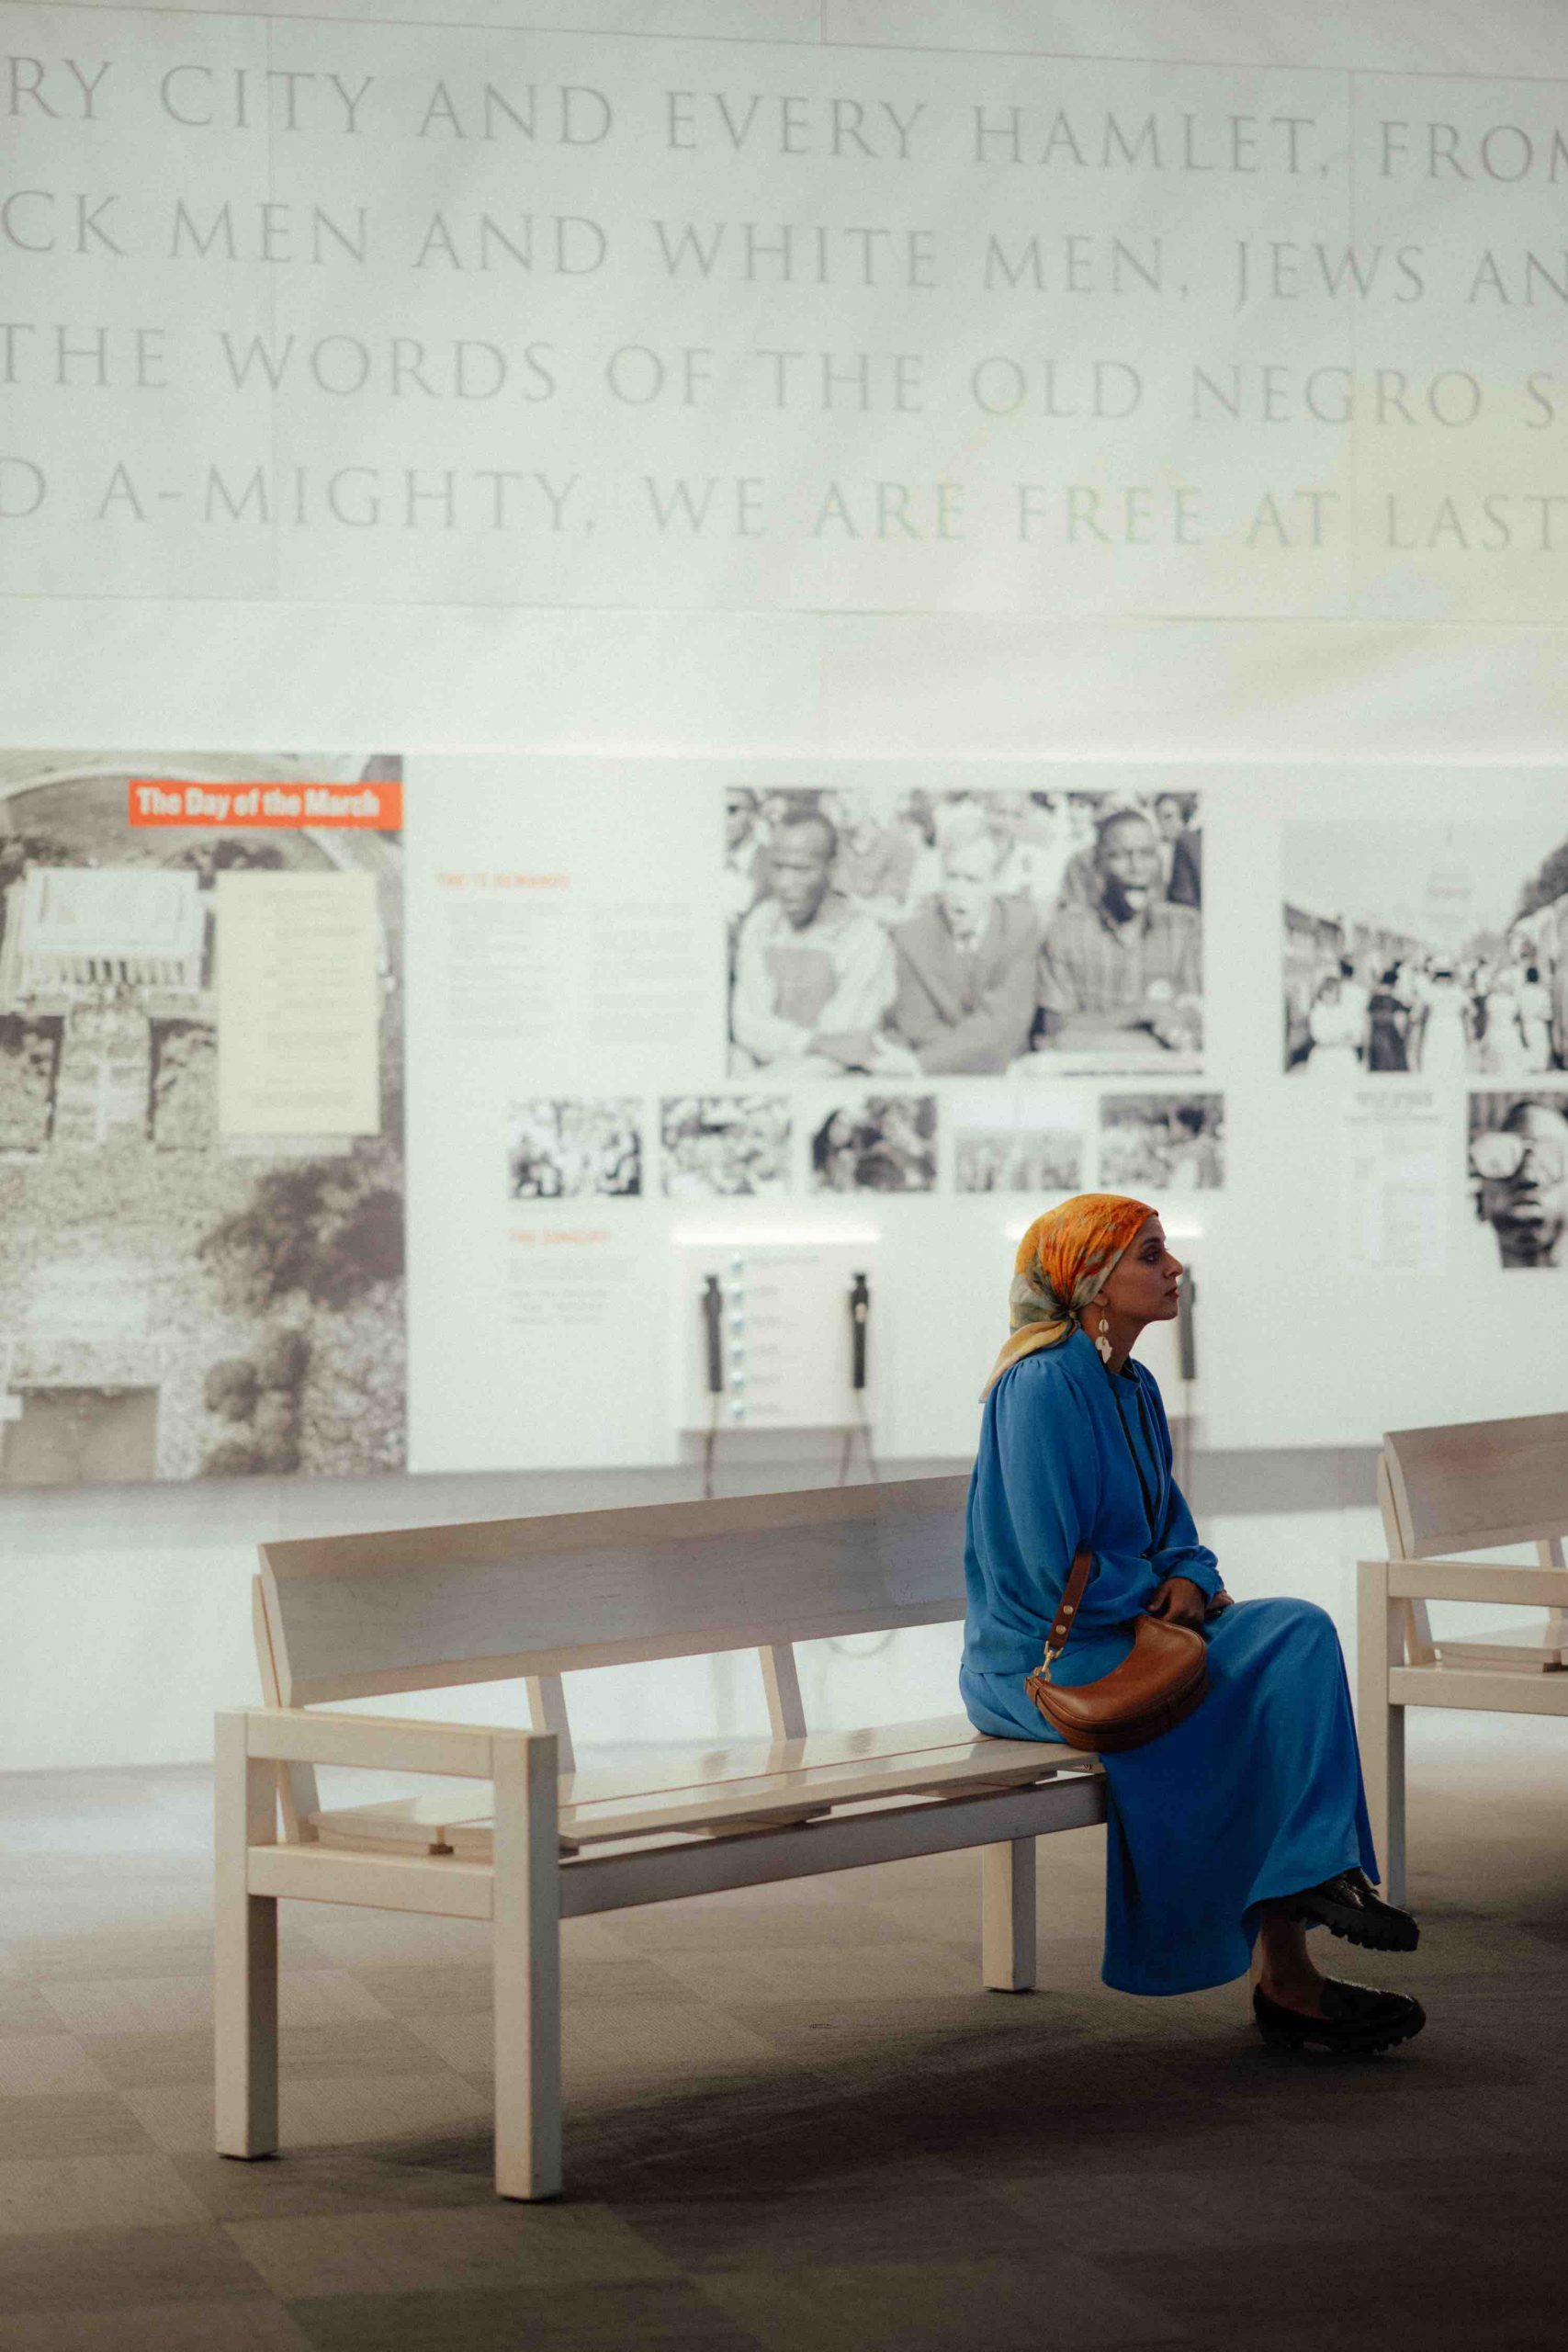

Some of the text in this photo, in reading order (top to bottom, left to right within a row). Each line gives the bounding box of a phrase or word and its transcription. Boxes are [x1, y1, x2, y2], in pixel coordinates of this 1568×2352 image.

[6, 56, 112, 120] RY
[160, 64, 375, 134] CITY
[416, 79, 614, 146] AND
[665, 90, 927, 160] EVERY
[0, 189, 127, 256] CK
[169, 198, 367, 265] MEN
[411, 209, 608, 275] AND
[650, 220, 938, 288] WHITE
[1236, 241, 1425, 311] JEWS
[1467, 249, 1568, 306] AN
[0, 322, 1554, 430] THE WORDS OF THE OLD NEGRO S
[640, 475, 767, 538] WE
[808, 481, 965, 540] ARE
[1015, 483, 1202, 546] FREE
[1246, 491, 1339, 548] AT
[1386, 492, 1568, 551] LAST
[137, 787, 379, 820] The Day of the March
